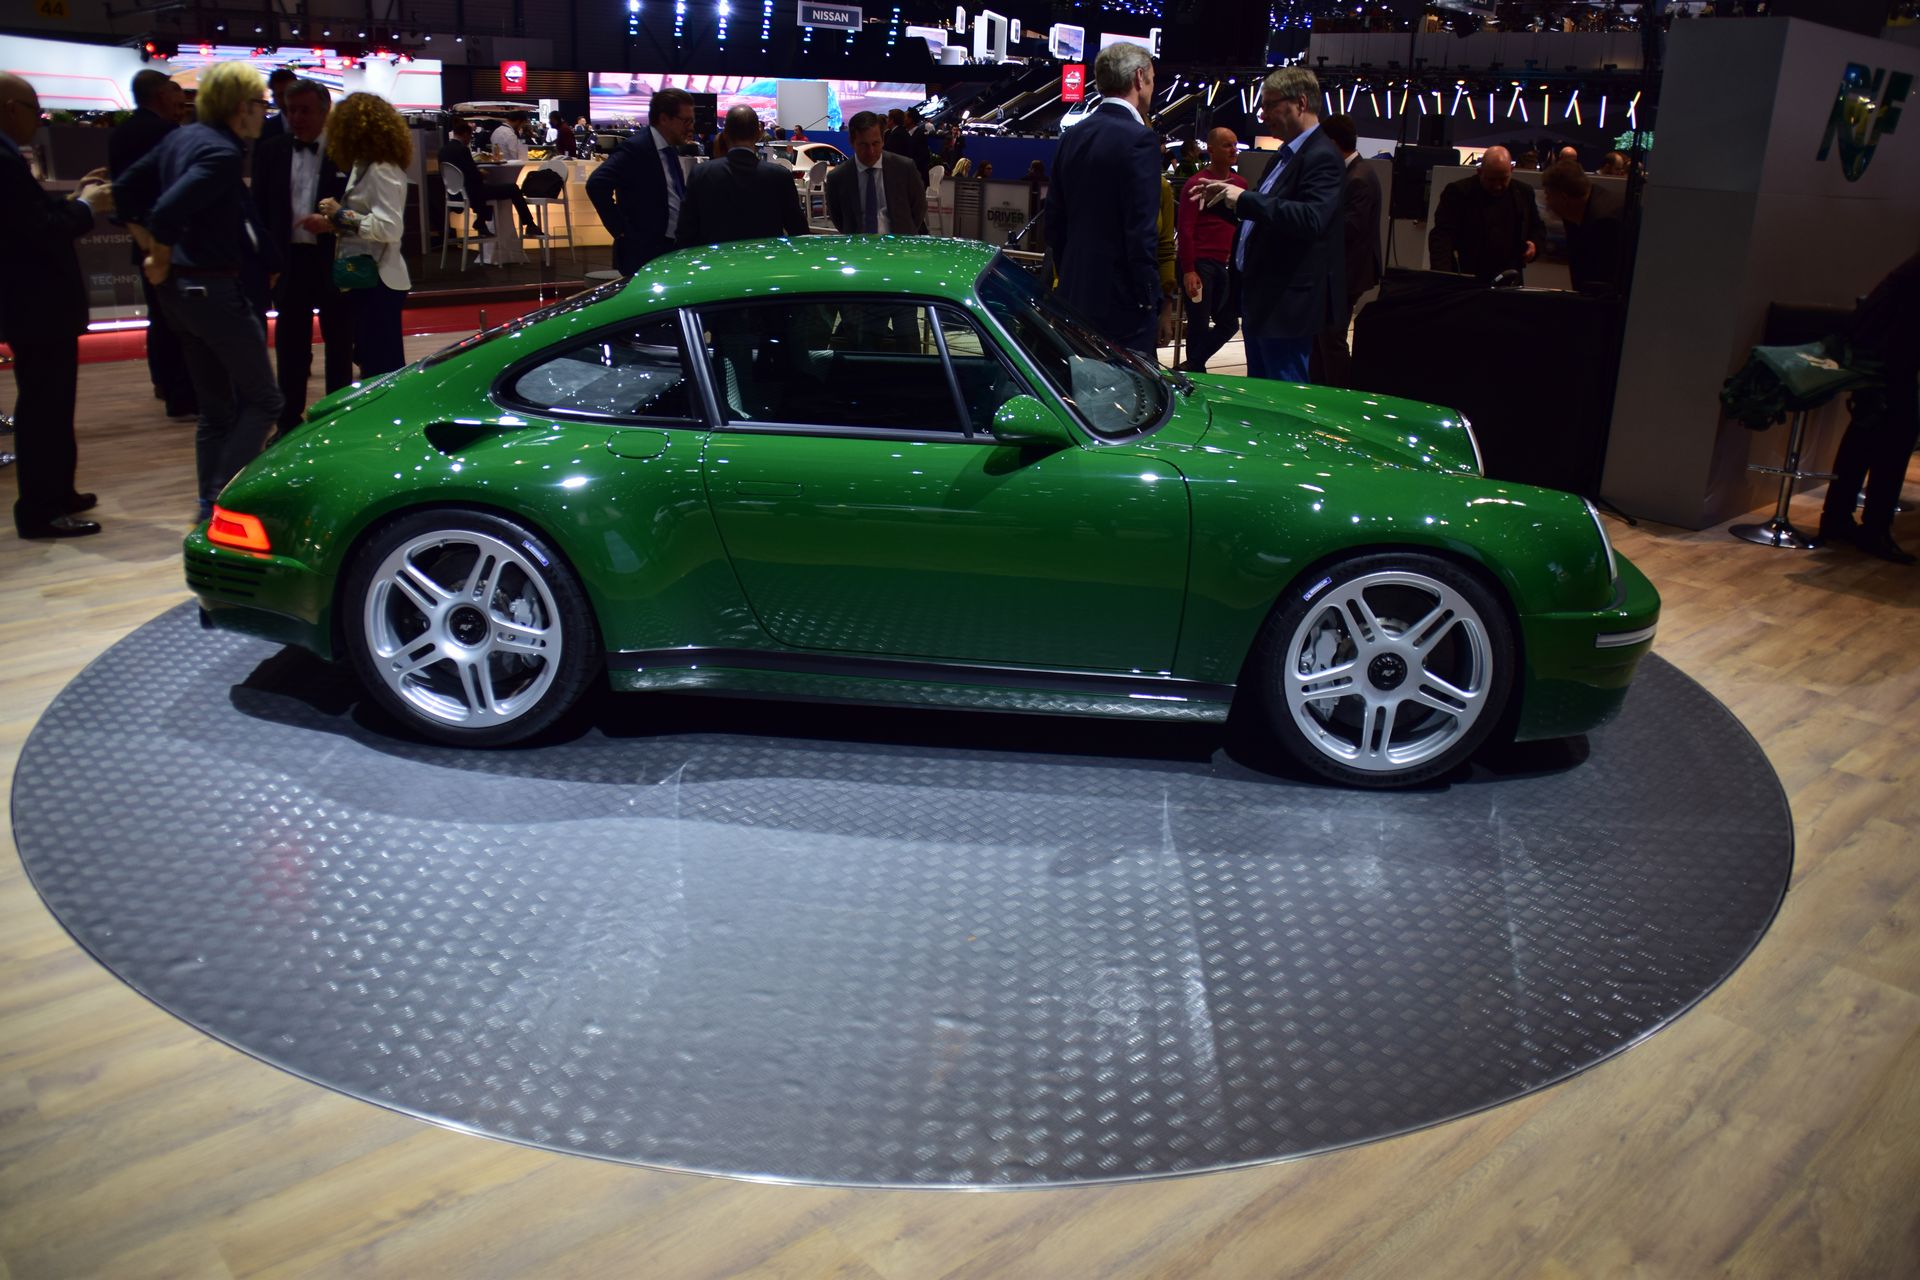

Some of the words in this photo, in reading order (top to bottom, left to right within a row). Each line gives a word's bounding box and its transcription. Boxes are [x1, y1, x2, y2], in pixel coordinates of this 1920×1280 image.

[40, 1, 64, 16] 44
[812, 9, 849, 23] NISSAN
[987, 210, 1025, 224] DRIVER
